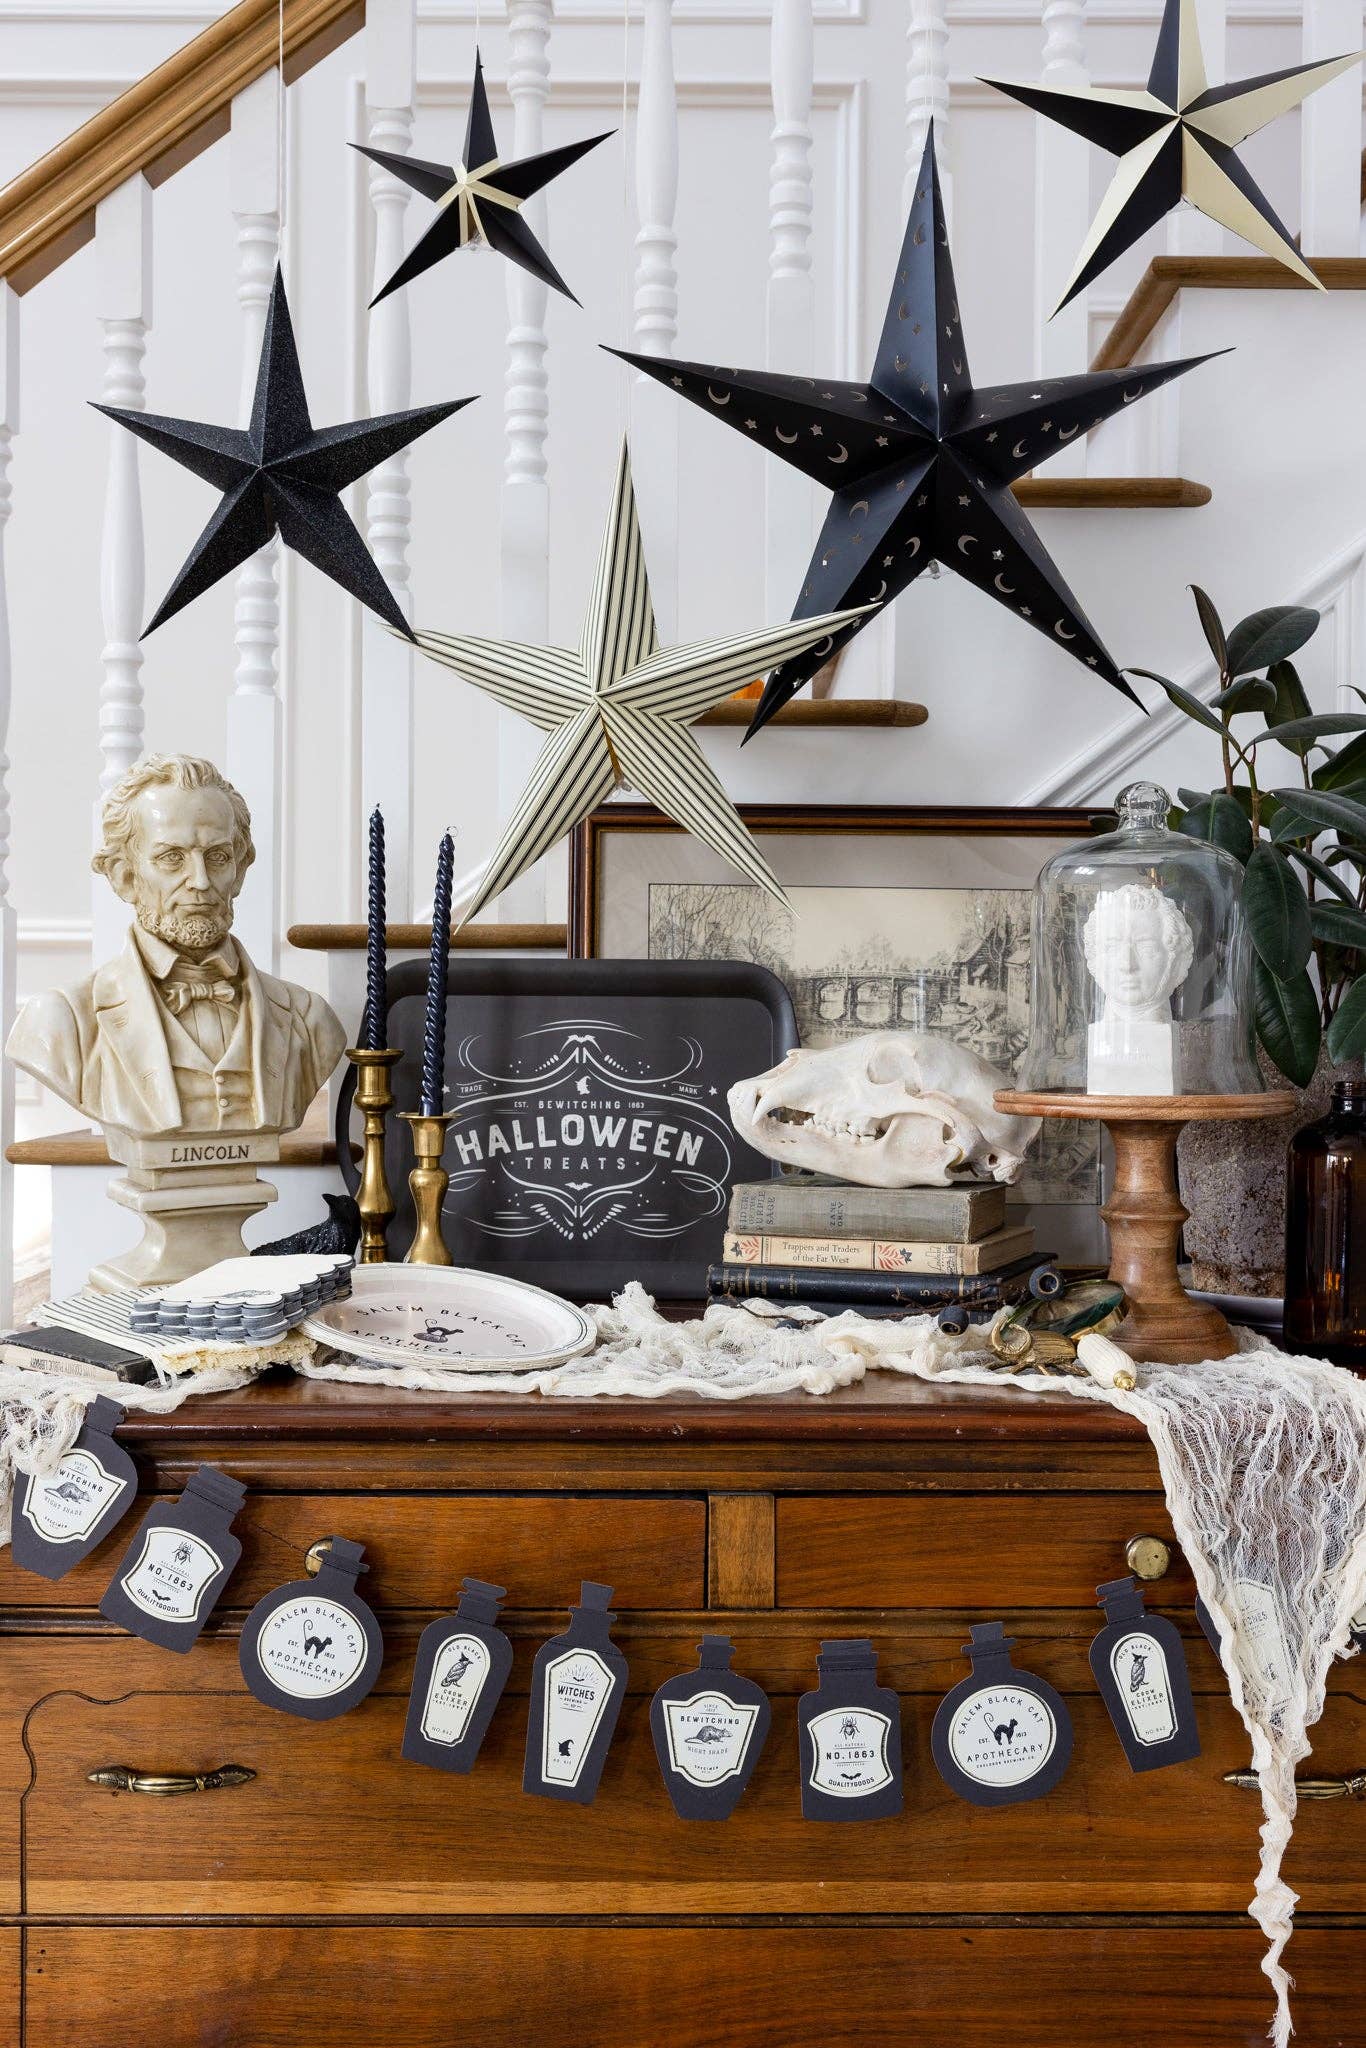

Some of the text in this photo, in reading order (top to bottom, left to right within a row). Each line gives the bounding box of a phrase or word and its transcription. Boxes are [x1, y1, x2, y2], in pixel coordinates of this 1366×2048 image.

[460, 1084, 698, 1095] TRADE MARK
[538, 1100, 622, 1110] BEWITCHING
[454, 1114, 704, 1166] HALLOWEEN
[170, 1145, 250, 1163] LINCOLN
[525, 1157, 626, 1170] TREATS
[740, 1191, 749, 1230] RIDERS
[756, 1191, 766, 1230] PURPLE
[767, 1196, 776, 1225] SAGE
[782, 1242, 860, 1253] Trappers and Traders
[831, 1255, 849, 1264] West
[356, 1306, 424, 1316] SALEM
[440, 1309, 504, 1330] BLACK
[350, 1330, 476, 1355] APOTHECA
[60, 1468, 104, 1492] WITCHING
[274, 1607, 356, 1654] SALEM BLACK CAT
[268, 1650, 344, 1680] APOTHECARY
[558, 1684, 595, 1700] WITCHES
[680, 1716, 740, 1724] BEWITCHING
[958, 1696, 1044, 1735] SALEM BLACK CAT
[967, 1744, 1043, 1762] APOTHECARY
